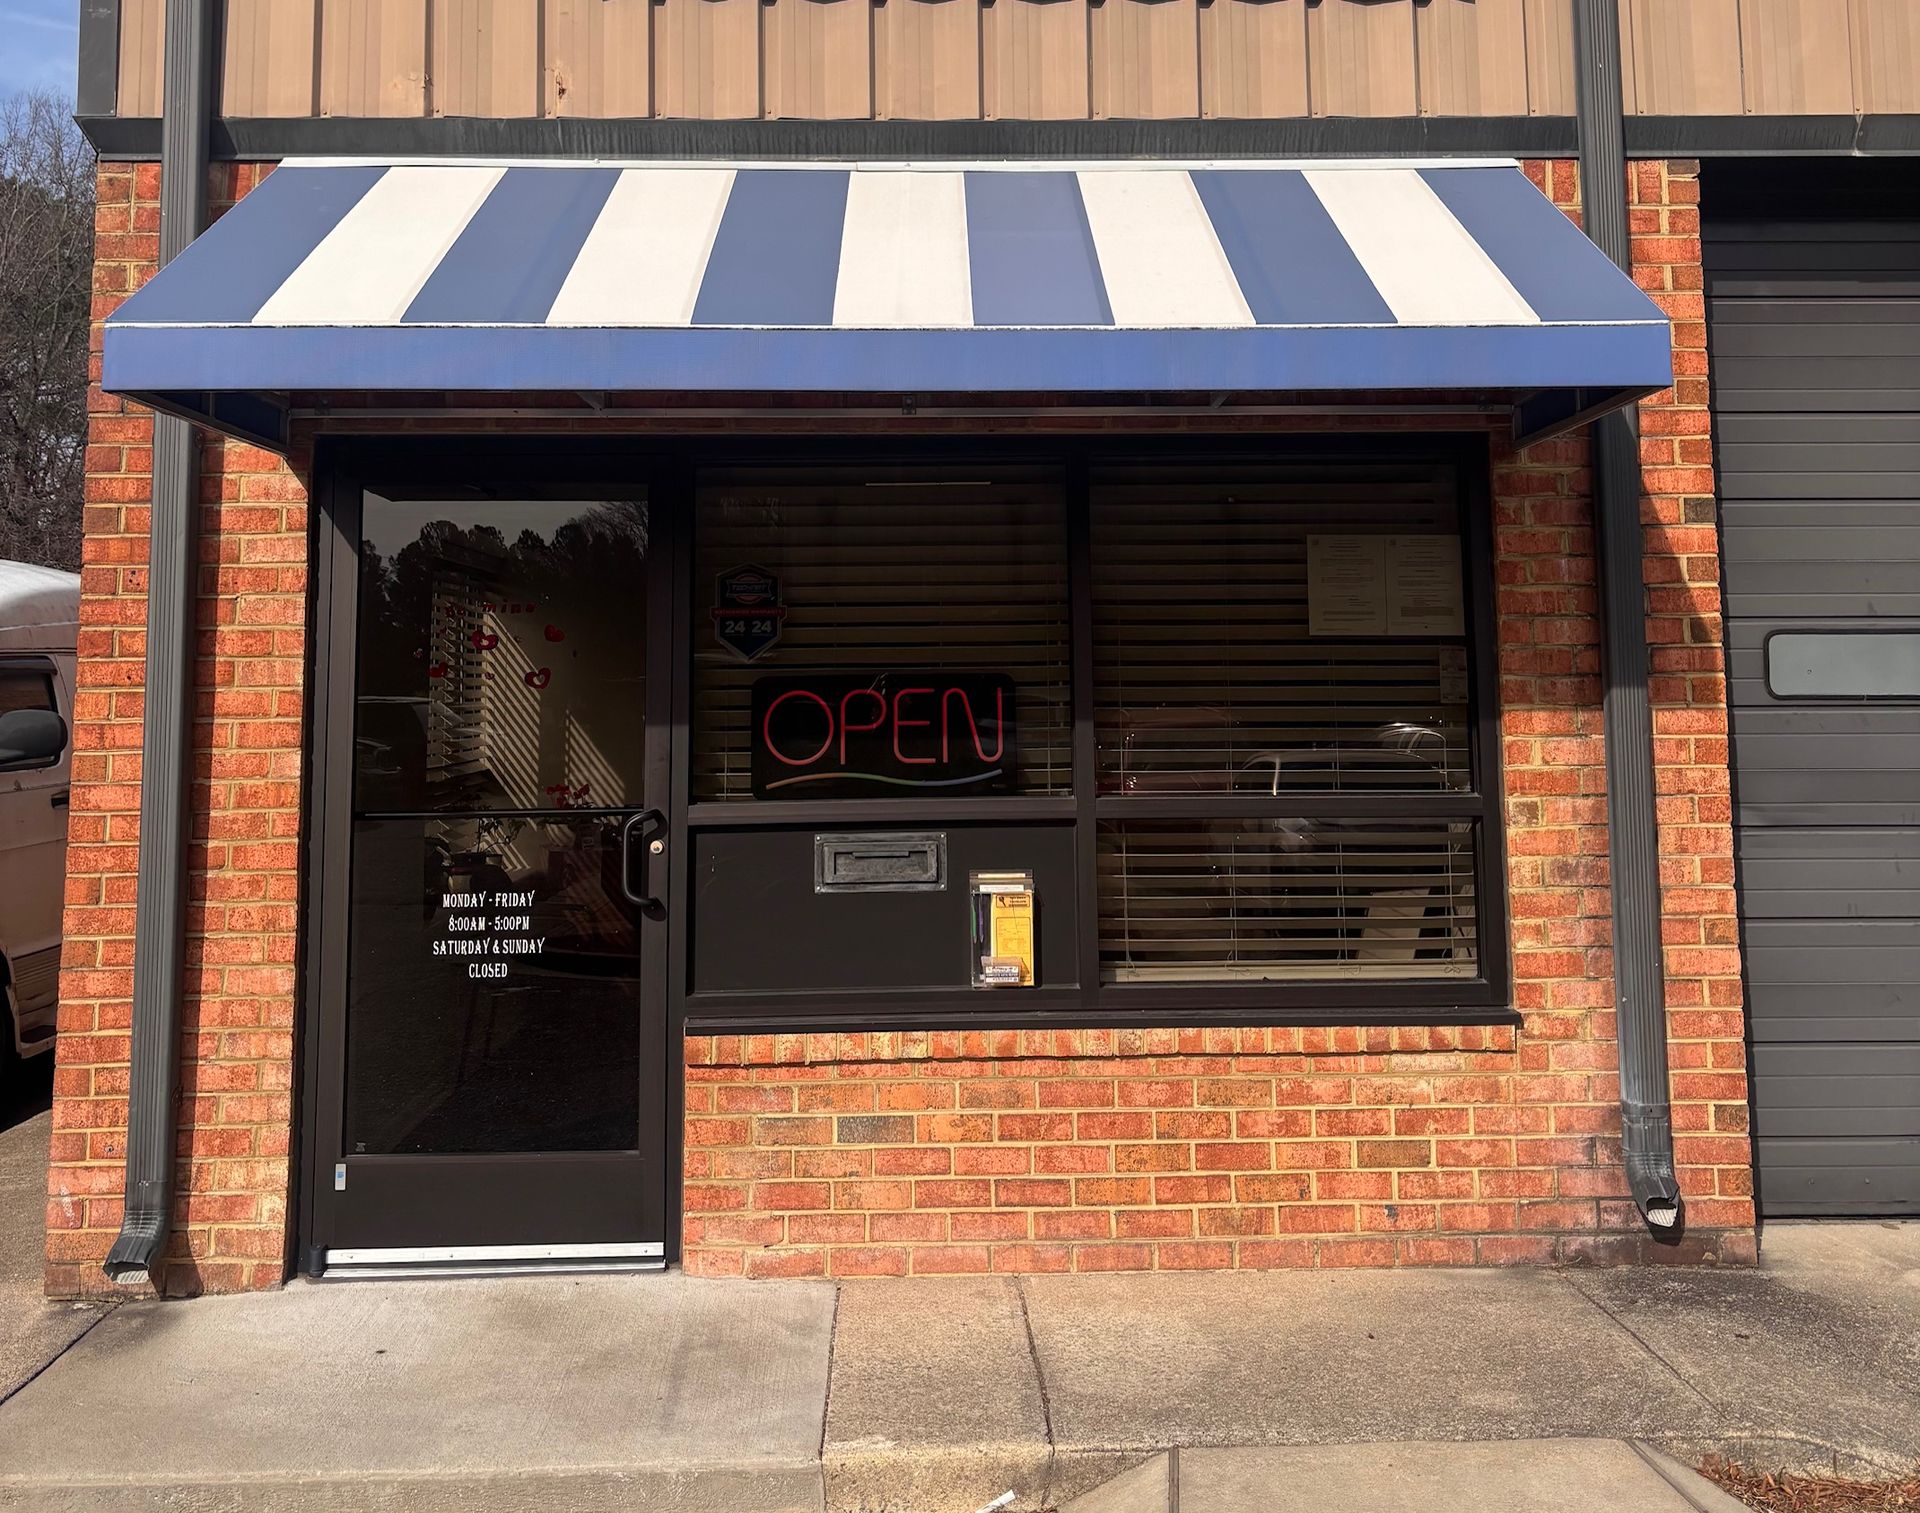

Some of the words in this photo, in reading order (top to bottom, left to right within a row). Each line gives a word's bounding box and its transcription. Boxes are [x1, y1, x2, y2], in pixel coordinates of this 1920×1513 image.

[724, 620, 746, 633] 24
[751, 620, 773, 633] 24
[763, 687, 1005, 766] OPEN
[442, 890, 487, 908] MONDAY
[495, 890, 535, 907] FRIDAY
[448, 914, 486, 931] 8:00AM
[494, 915, 530, 931] 5:00PM
[432, 937, 491, 955] SATURDAY
[492, 939, 500, 955] &
[502, 937, 545, 954] SUNDAY
[468, 963, 508, 978] CLOSED
